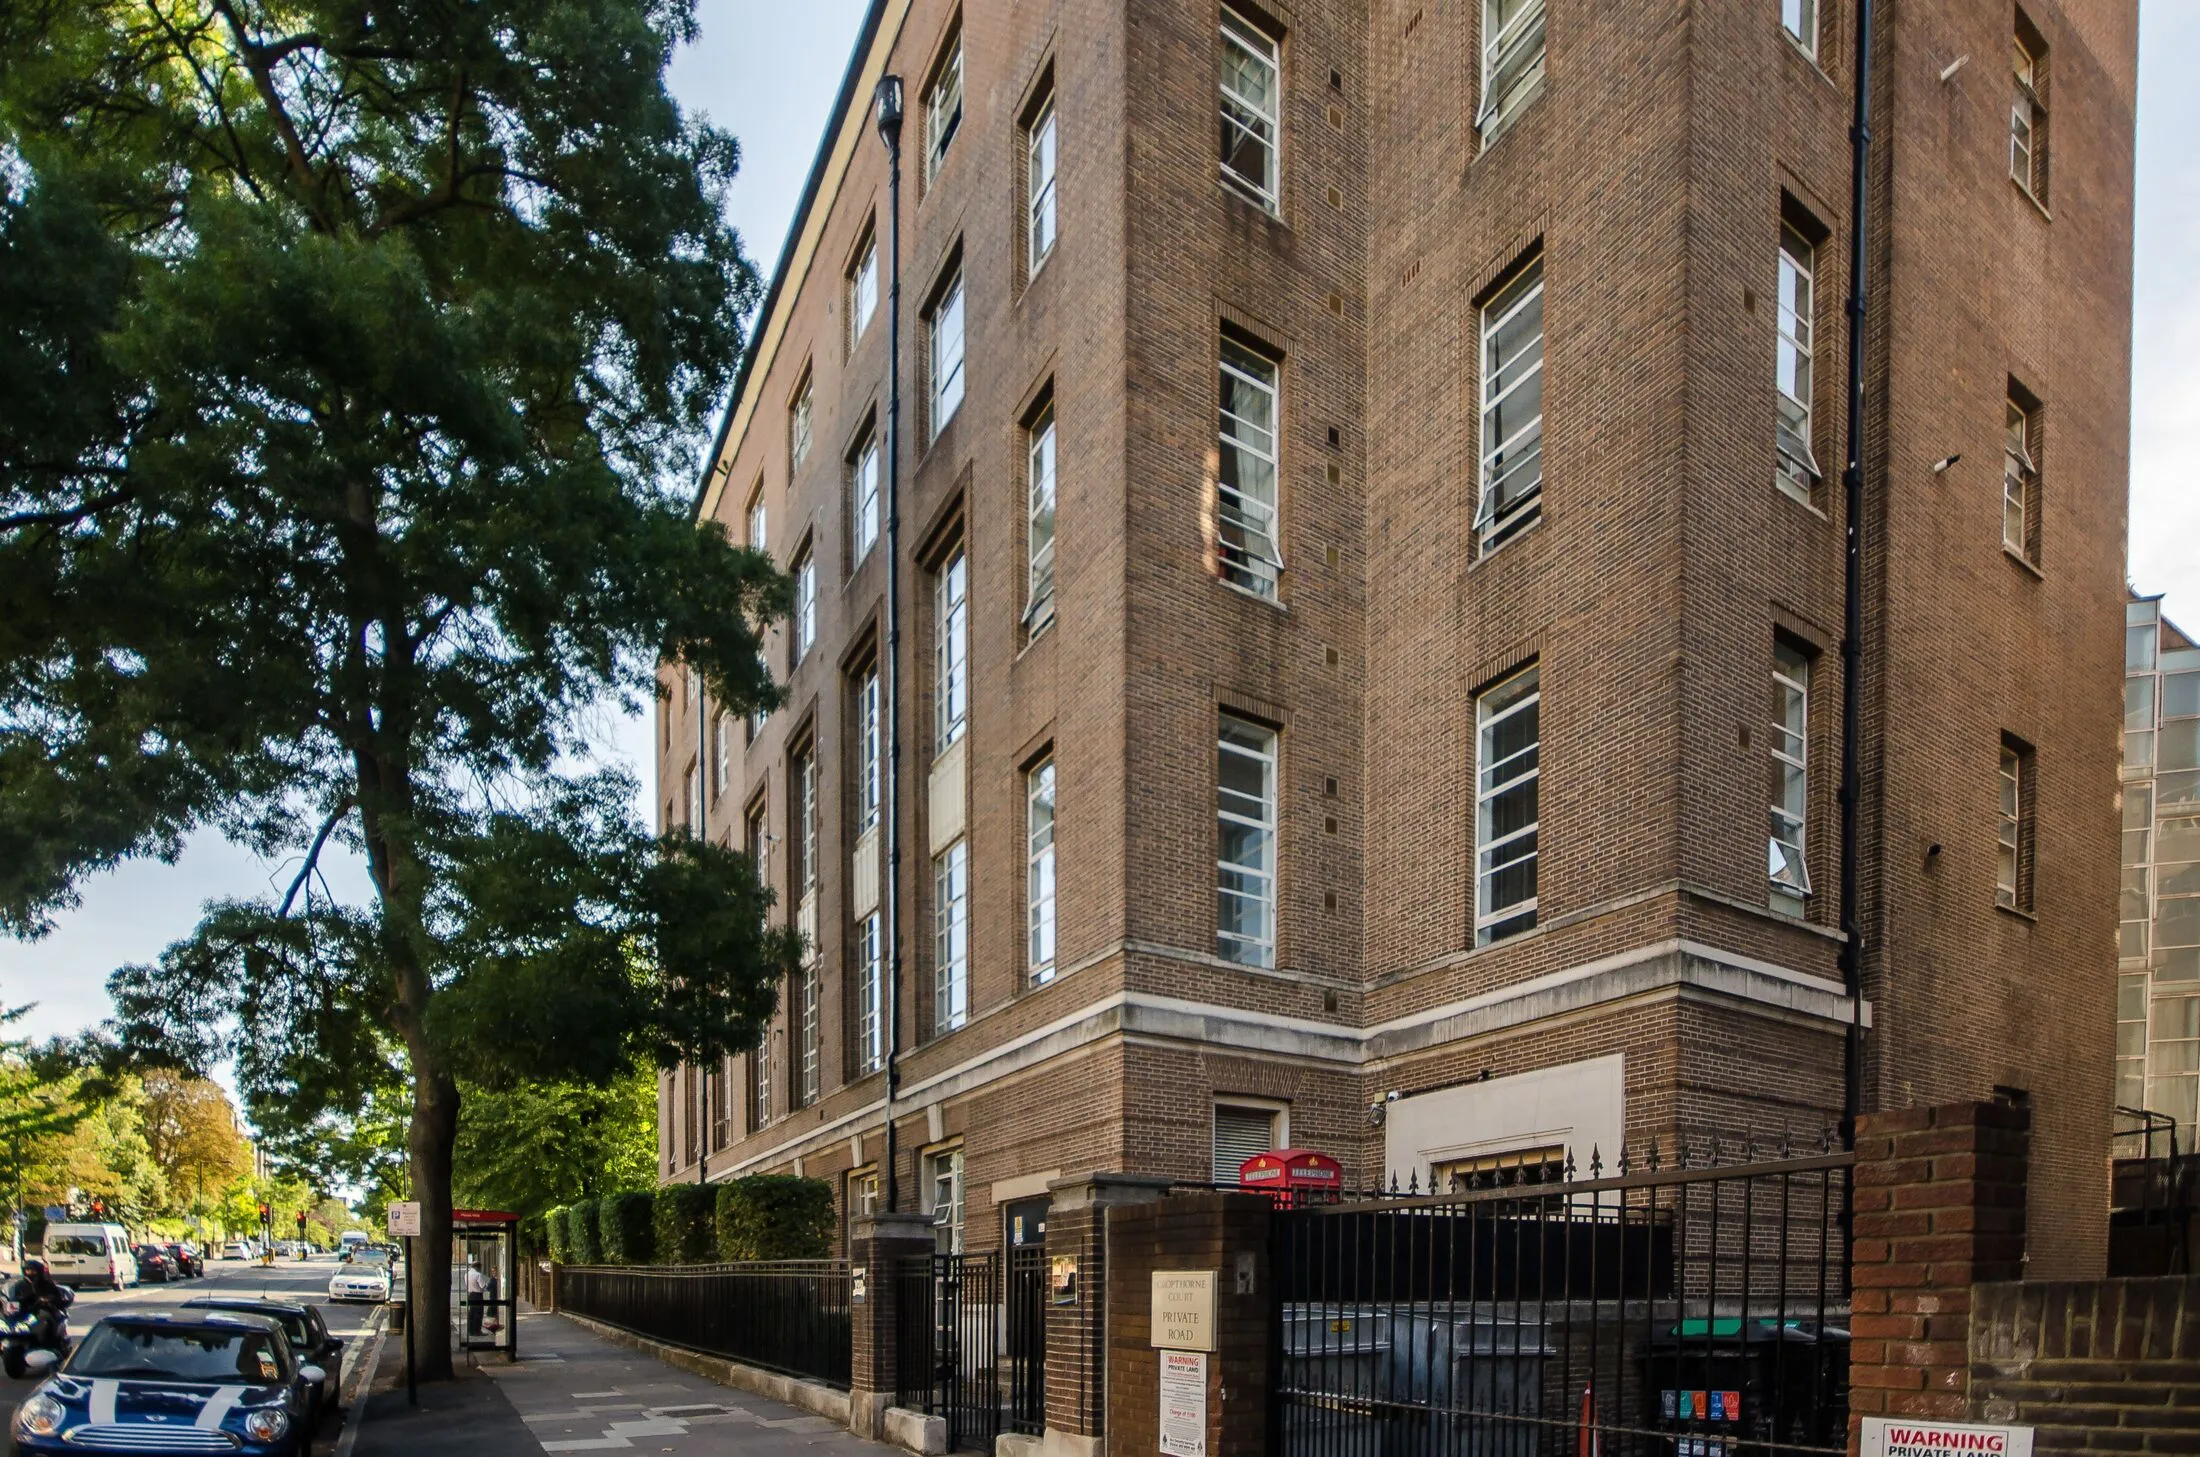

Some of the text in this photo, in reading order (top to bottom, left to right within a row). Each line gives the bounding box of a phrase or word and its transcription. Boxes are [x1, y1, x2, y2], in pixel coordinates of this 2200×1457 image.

[1168, 1292, 1193, 1302] COURT
[1163, 1312, 1200, 1324] PRIVATE
[1168, 1329, 1194, 1341] ROAD
[1168, 1355, 1199, 1367] WARNING
[1168, 1364, 1185, 1372] PRIVATE
[1890, 1429, 2003, 1451] WARNING
[1889, 1446, 1951, 1457] PRIVATE
